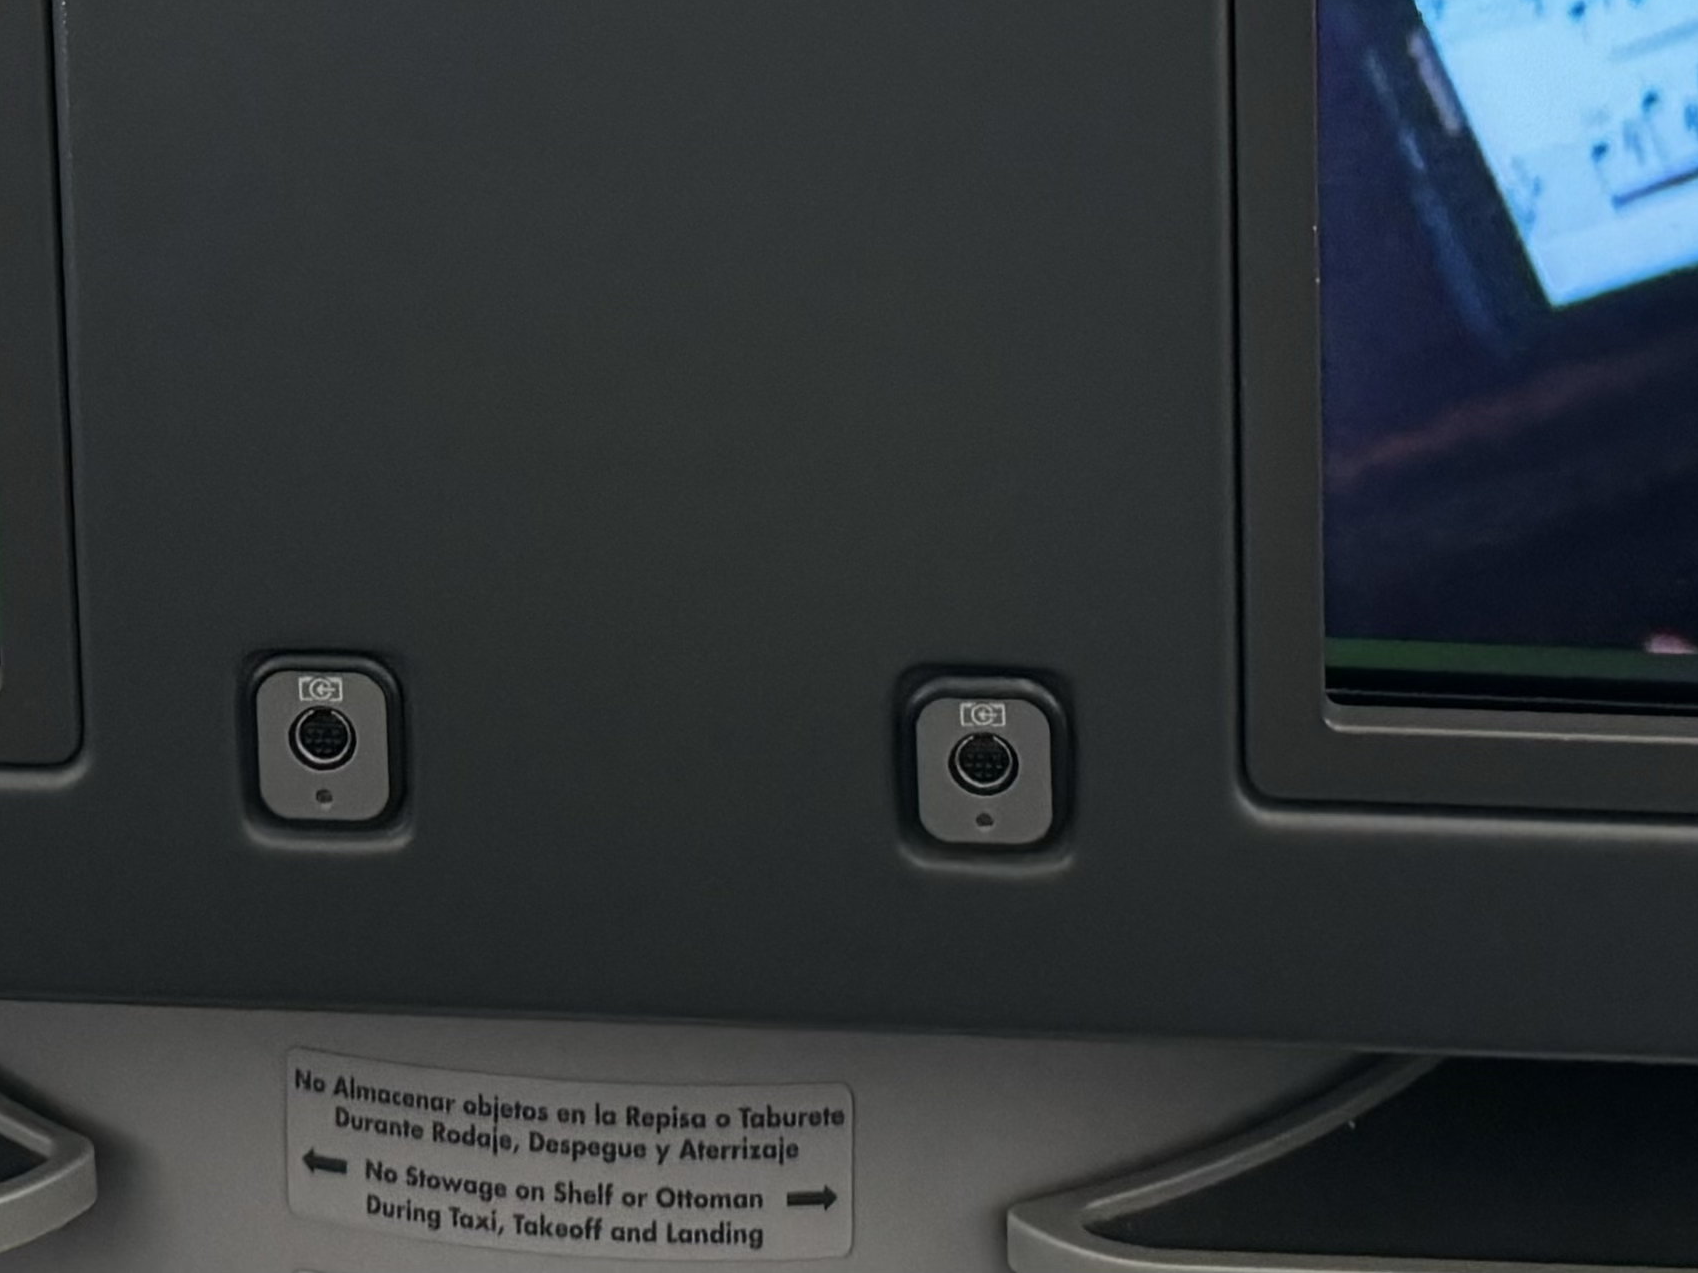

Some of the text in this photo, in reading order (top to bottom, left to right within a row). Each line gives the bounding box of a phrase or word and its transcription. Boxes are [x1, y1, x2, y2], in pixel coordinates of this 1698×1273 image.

[295, 1068, 845, 1134] No Almacenar objetos en la Repisa o Taburete
[335, 1106, 799, 1165] Durante Rodaje, Despegue y Aterrizaje
[365, 1158, 763, 1209] No Stowage on Shelf or Ottoman
[366, 1194, 764, 1250] During Taxi, Takeoff and Landing
